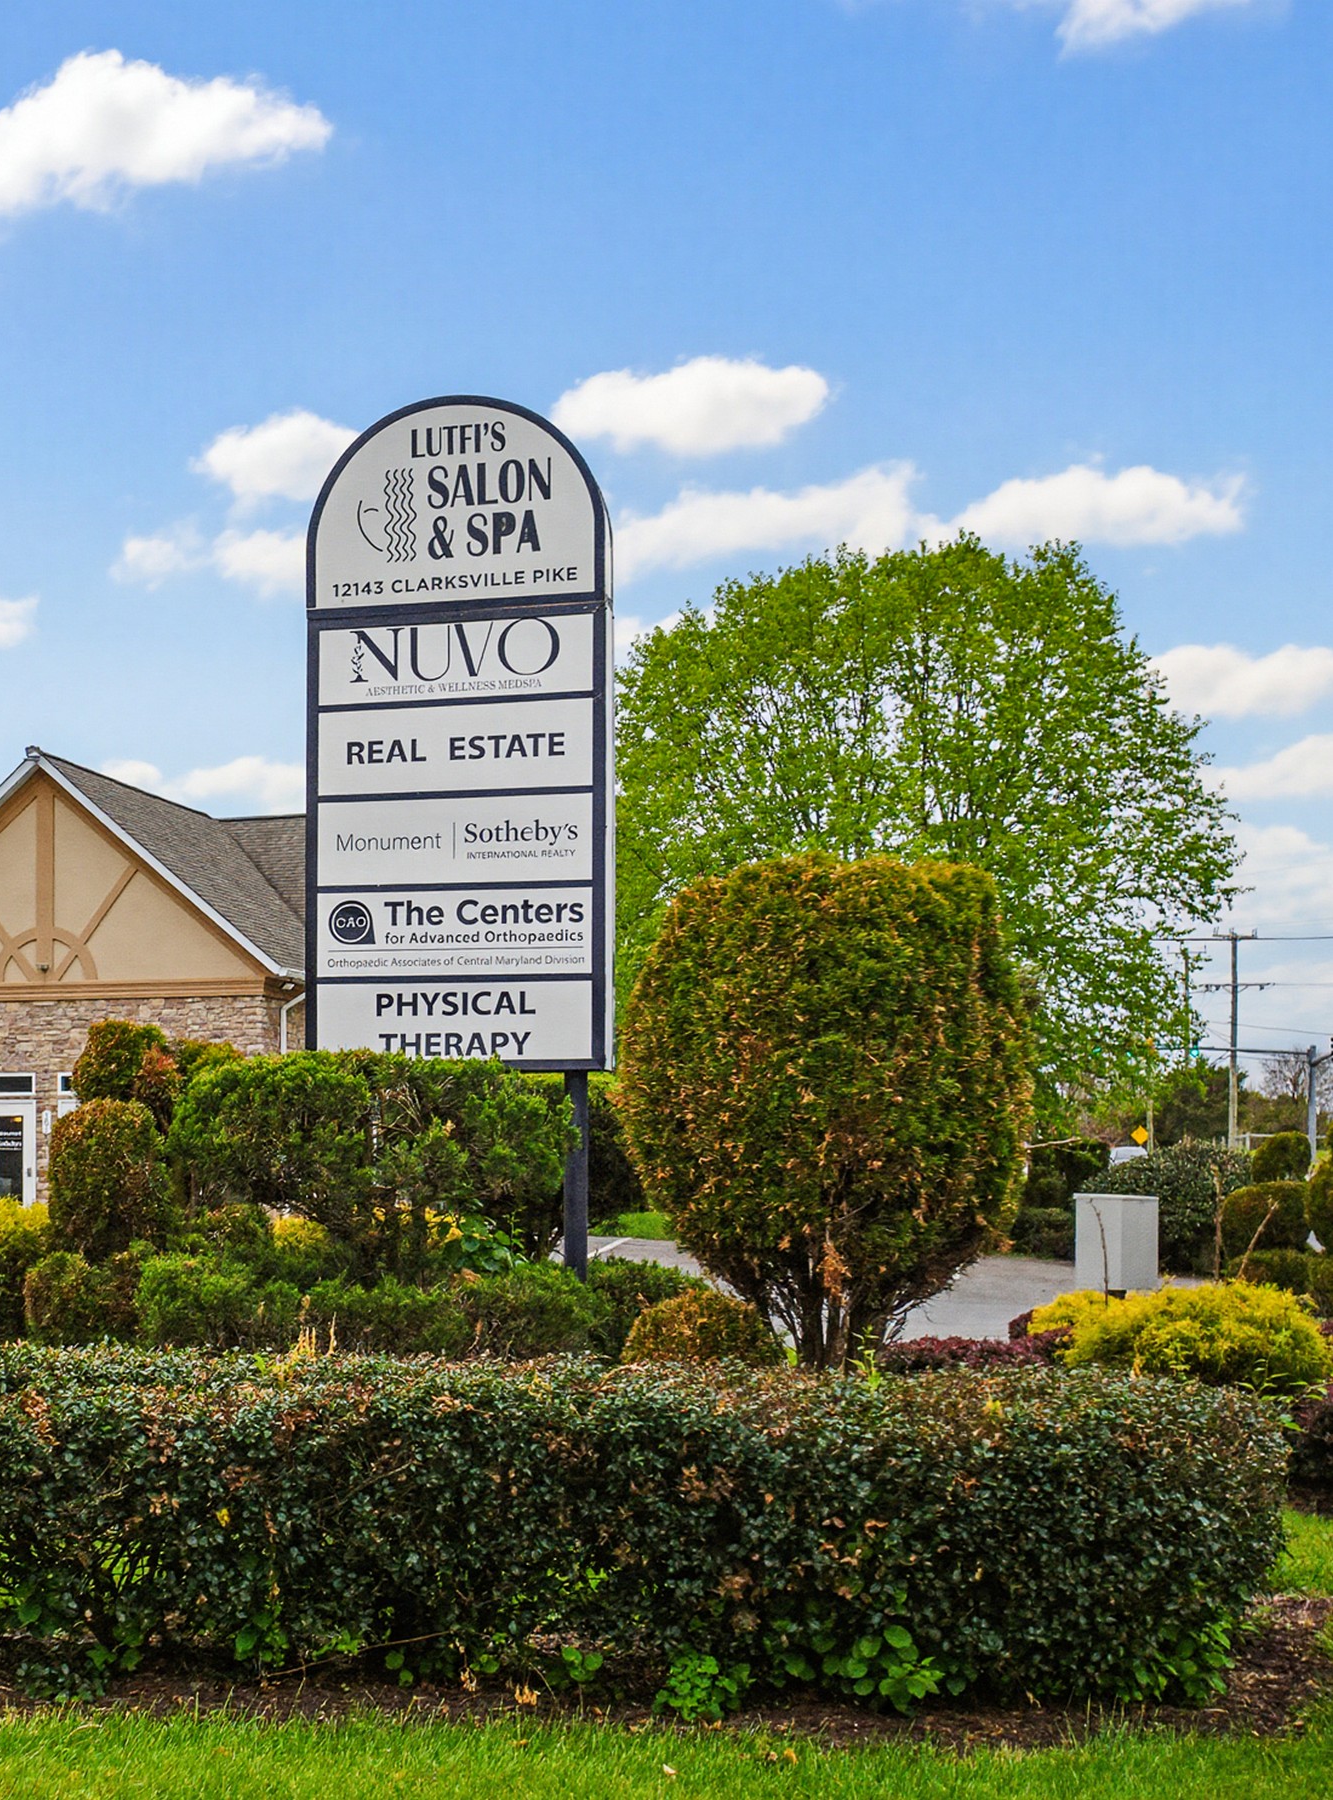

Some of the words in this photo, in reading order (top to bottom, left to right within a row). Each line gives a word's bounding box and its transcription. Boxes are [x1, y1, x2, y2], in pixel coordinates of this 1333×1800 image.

[410, 421, 506, 459] LUTFI'S
[427, 456, 552, 510] SALON
[427, 515, 454, 561] &
[466, 509, 541, 557] SPA
[332, 580, 384, 598] 12143
[391, 570, 526, 594] CLARKSVILLE
[532, 566, 579, 584] PIKE
[349, 616, 561, 683] NUVO
[366, 684, 426, 697] AESTHETIC
[427, 684, 436, 694] &
[438, 680, 496, 693] WELLNESS
[498, 678, 543, 690] MEDSPA
[346, 738, 427, 765] REAL
[449, 732, 566, 761] ESTATE
[336, 832, 442, 852] Monument
[463, 819, 578, 846] Sotheby's
[466, 849, 539, 861] INTERNATIONAL
[540, 848, 577, 859] REALTY
[384, 899, 445, 927] The
[456, 899, 584, 925] Centers
[385, 932, 405, 945] for
[409, 931, 480, 944] Advanced
[484, 929, 584, 945] Orthopaedics
[327, 957, 388, 969] Orthopaedic
[391, 956, 442, 968] Associates
[443, 956, 454, 966] of
[457, 955, 493, 966] Central
[495, 954, 542, 967] Maryland
[544, 954, 585, 965] Division
[376, 991, 536, 1017] PHYSICAL
[378, 1031, 532, 1057] THERAPY
